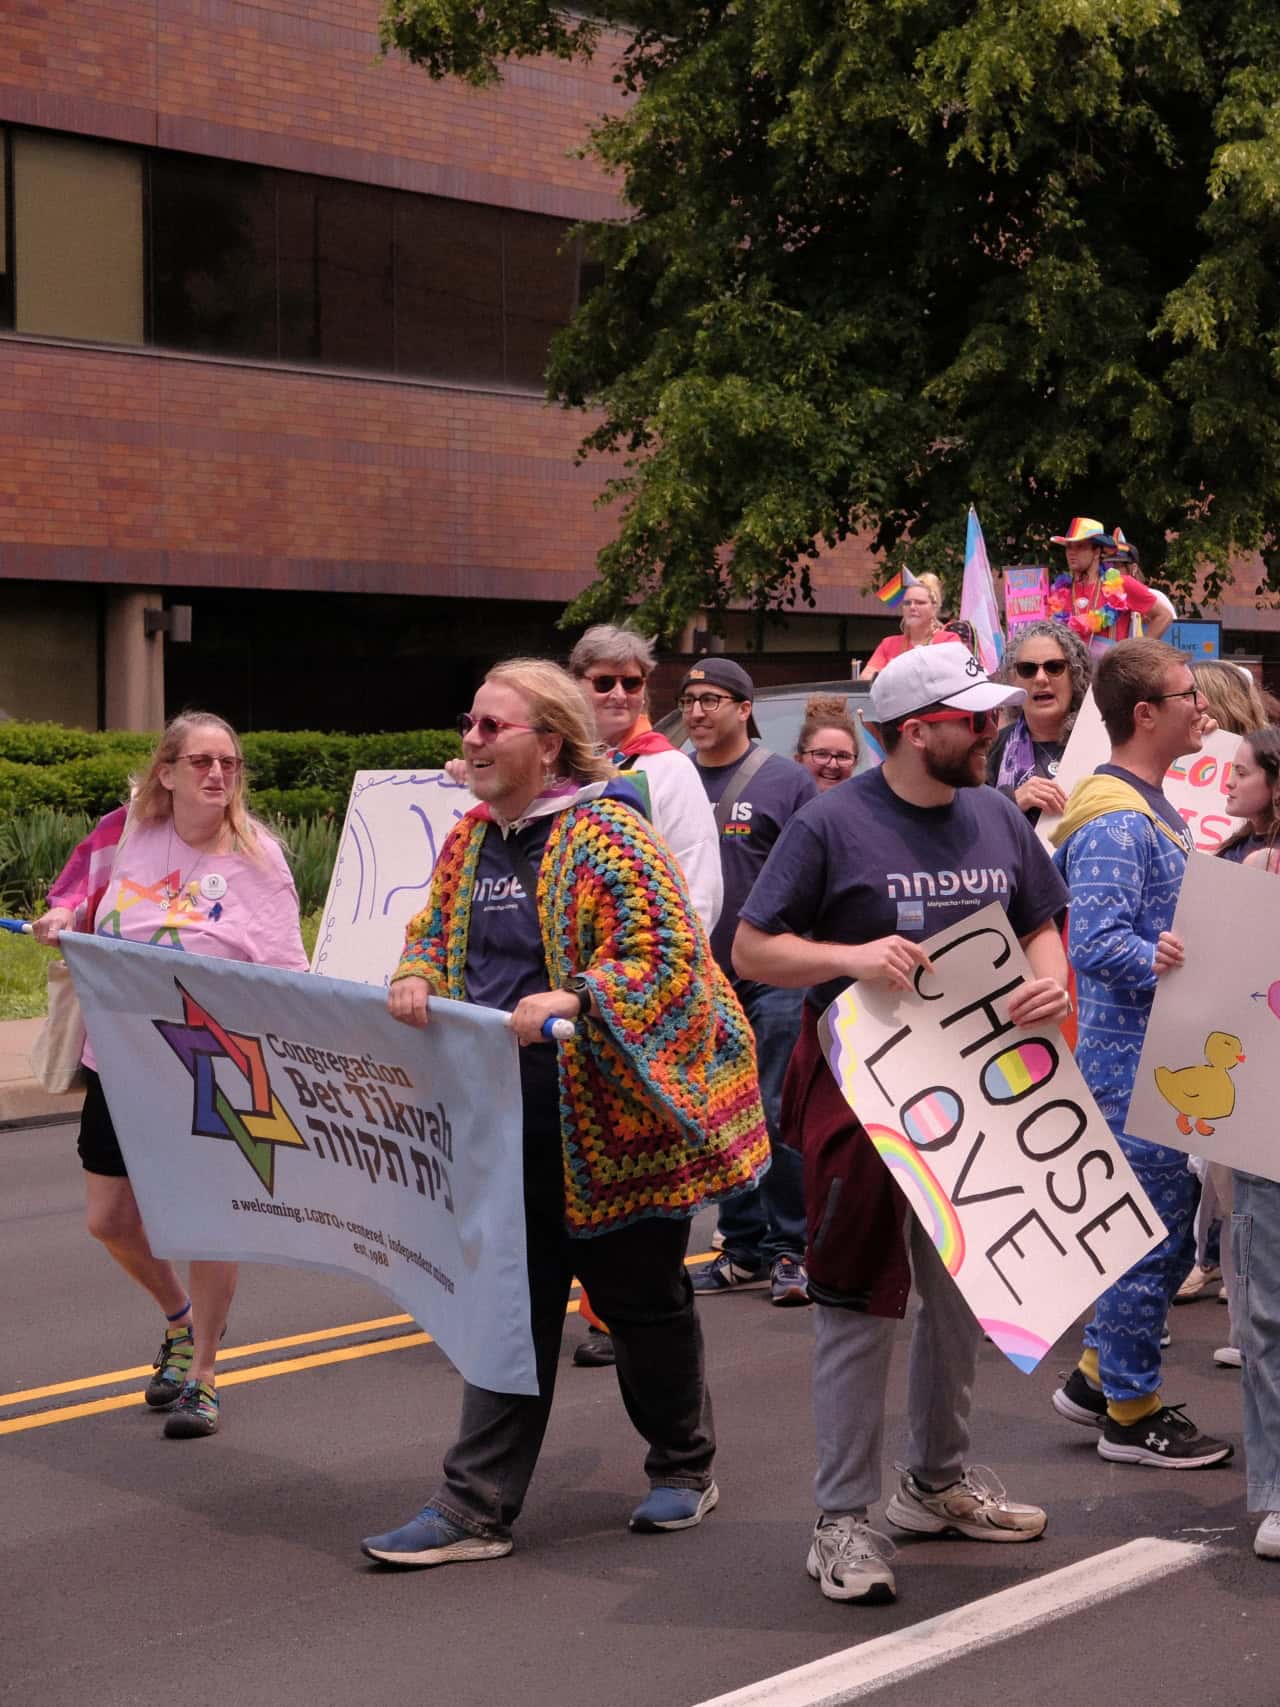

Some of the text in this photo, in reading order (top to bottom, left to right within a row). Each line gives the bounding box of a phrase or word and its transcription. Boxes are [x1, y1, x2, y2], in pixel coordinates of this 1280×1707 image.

[731, 802, 753, 821] IS
[886, 868, 1008, 899] משפחה
[266, 1033, 414, 1088] Congregation
[283, 1066, 453, 1163] Bet Tikvah
[913, 927, 1155, 1275] CHOOSE
[306, 1114, 409, 1188] תקווה
[864, 1025, 1068, 1306] LOVE
[231, 1199, 240, 1211] a
[240, 1199, 305, 1223] welcoming,
[305, 1207, 345, 1230] LGBTQ+
[388, 1234, 433, 1274] independent
